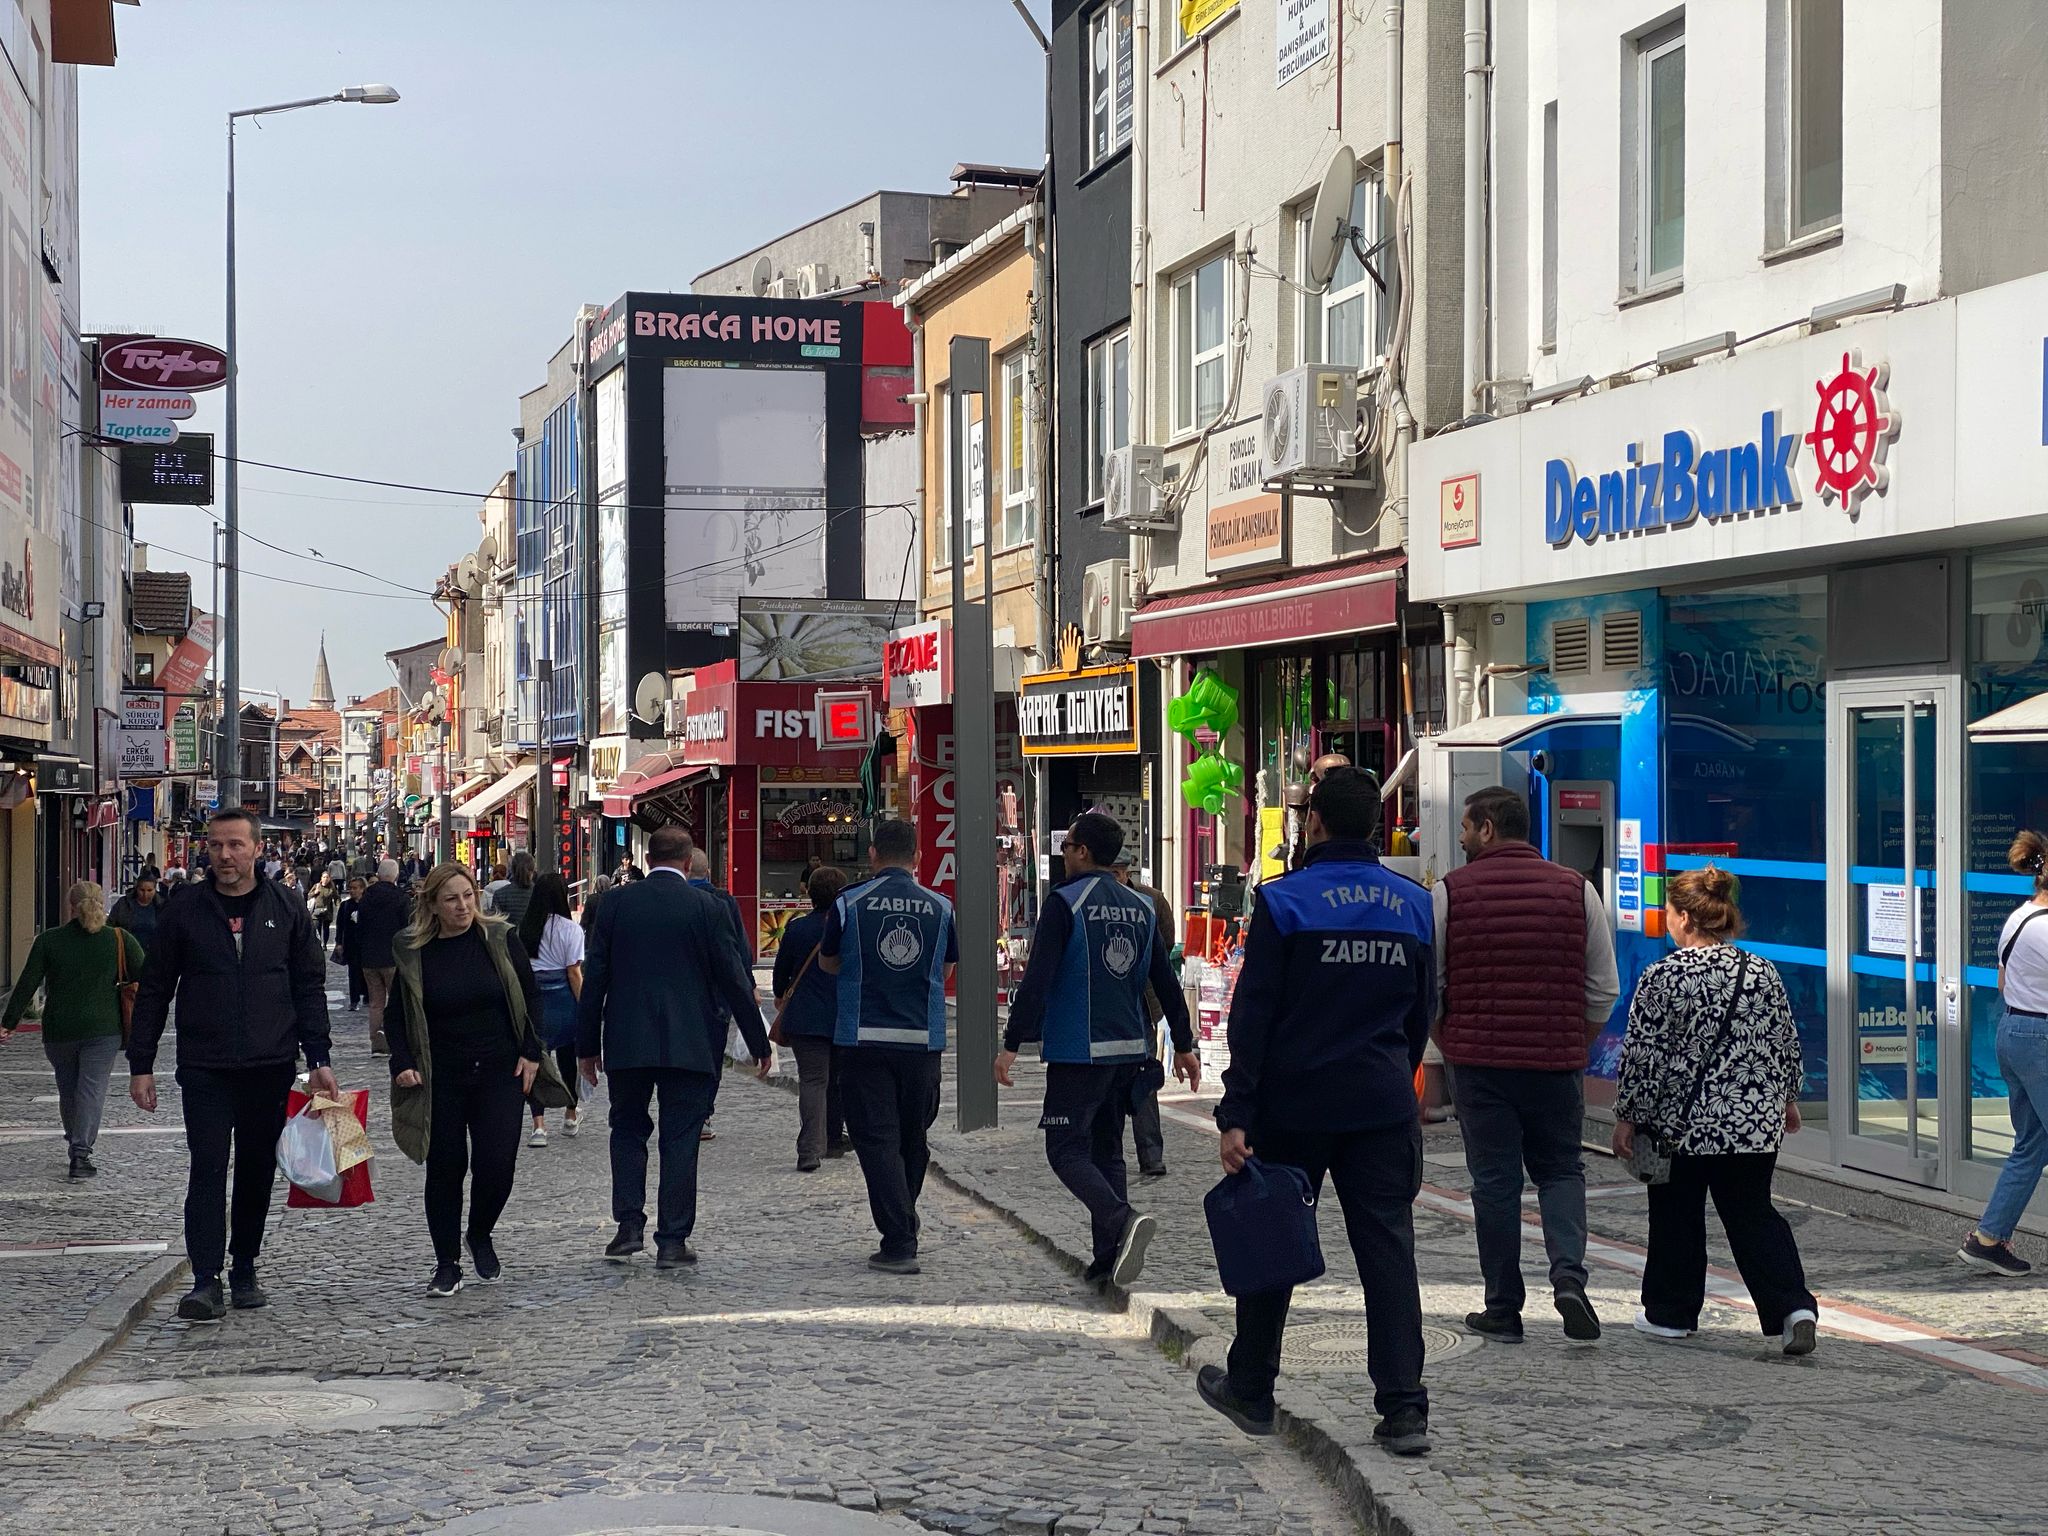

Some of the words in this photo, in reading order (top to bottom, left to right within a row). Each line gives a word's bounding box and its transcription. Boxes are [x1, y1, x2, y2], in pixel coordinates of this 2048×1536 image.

[1299, 15, 1304, 31] &
[1279, 17, 1326, 62] DANIŞMANLIK
[1278, 38, 1327, 83] TERCÜMANLIK
[751, 315, 841, 344] HOME
[105, 394, 134, 409] Her
[136, 397, 192, 410] zaman
[106, 422, 171, 439] Taptaze
[1230, 435, 1256, 462] PSİKOLOG
[1229, 460, 1257, 492] ASLIHAN
[1546, 410, 1799, 545] DenizBank
[1210, 511, 1241, 549] PSİKOLOJİK
[1241, 508, 1279, 547] DANIŞMANLIK
[1443, 518, 1474, 532] MoneyGram
[1187, 612, 1247, 645] KARAÇAVUŞ
[1251, 602, 1313, 634] NALBURİYE
[906, 678, 922, 699] ÖMÜR
[126, 711, 160, 719] SÜRÜCÜ
[127, 701, 159, 709] CESUR
[1019, 693, 1060, 737] KAPAK
[1066, 686, 1129, 735] DÜNYASI
[829, 703, 860, 738] E
[126, 747, 150, 755] ERKEK
[780, 801, 869, 829] FISTIKÇIOĞLU
[792, 825, 858, 835] BAKLAVALARI
[866, 896, 934, 916] ZABITA
[1321, 885, 1405, 917] TRAFİK
[1086, 905, 1148, 926] ZABITA
[1321, 939, 1408, 967] ZABITA
[1042, 1116, 1070, 1126] ZABITA
